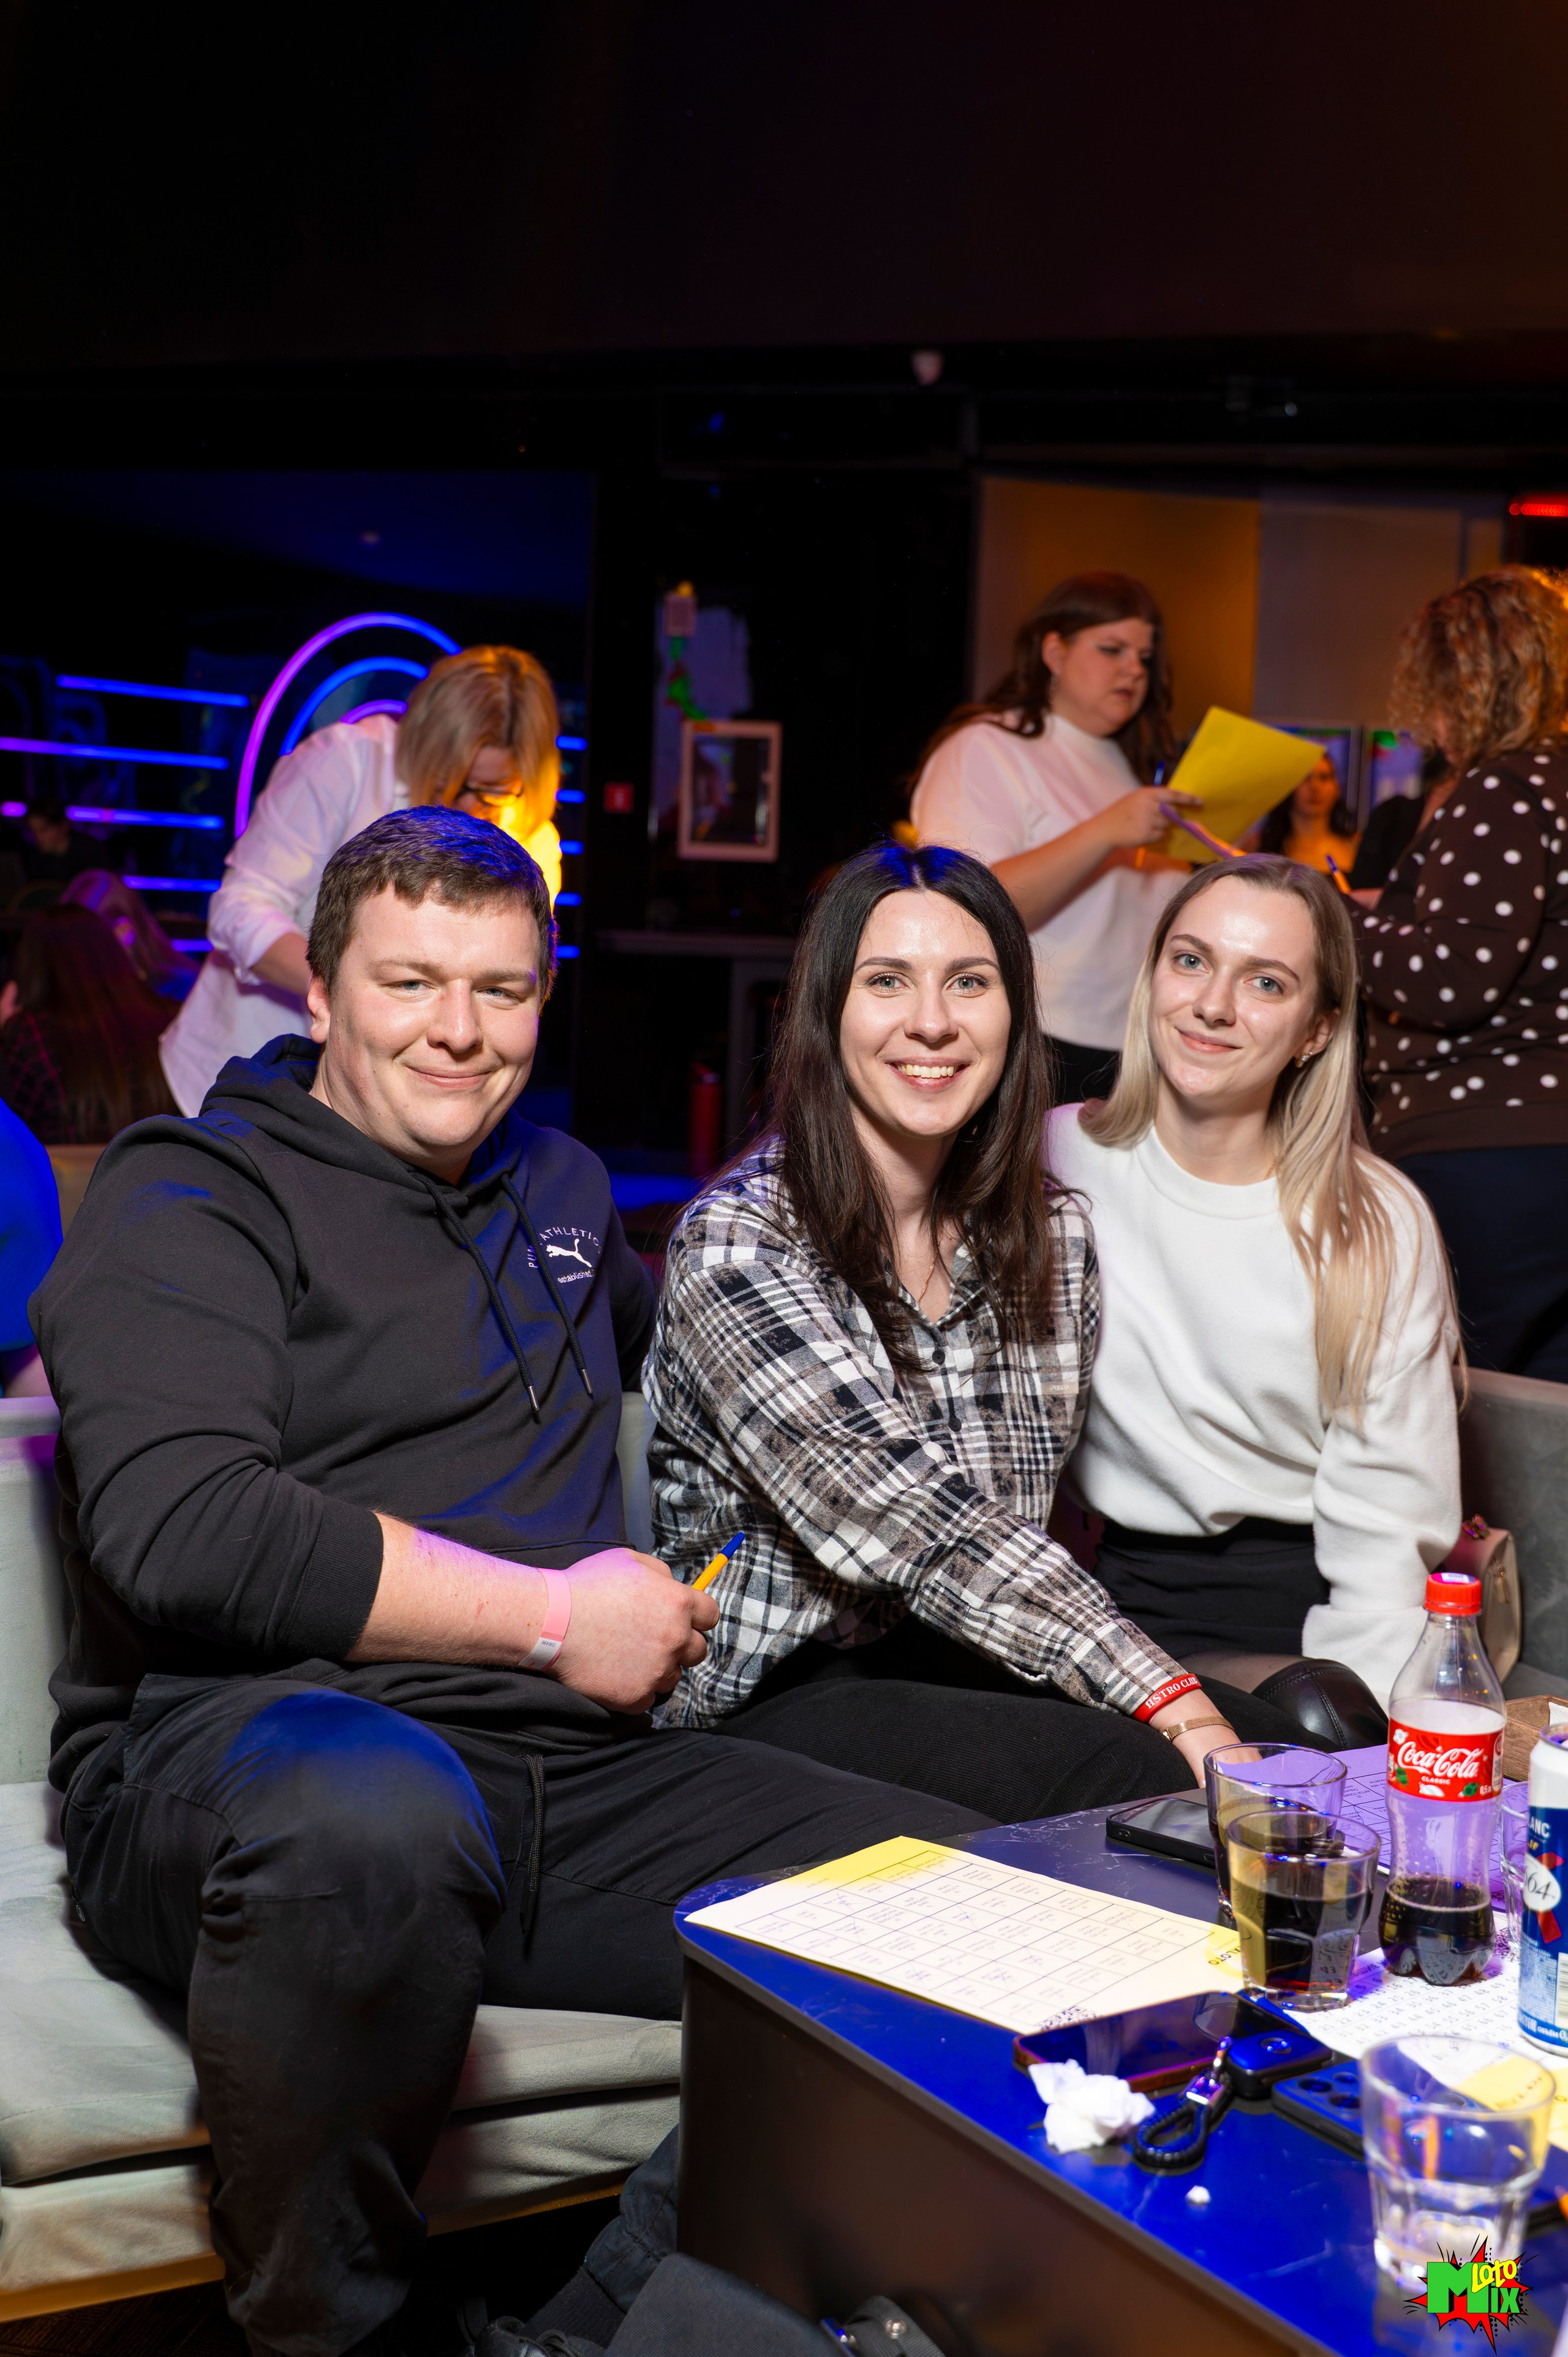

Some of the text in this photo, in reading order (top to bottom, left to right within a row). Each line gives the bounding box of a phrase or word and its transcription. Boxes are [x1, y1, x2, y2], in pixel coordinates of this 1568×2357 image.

[1145, 1677, 1198, 1709] ASTRO CLUB
[1397, 1741, 1485, 1779] Coca-Cola
[1421, 1776, 1451, 1785] CLASSIC
[1528, 1816, 1550, 1838] ANC
